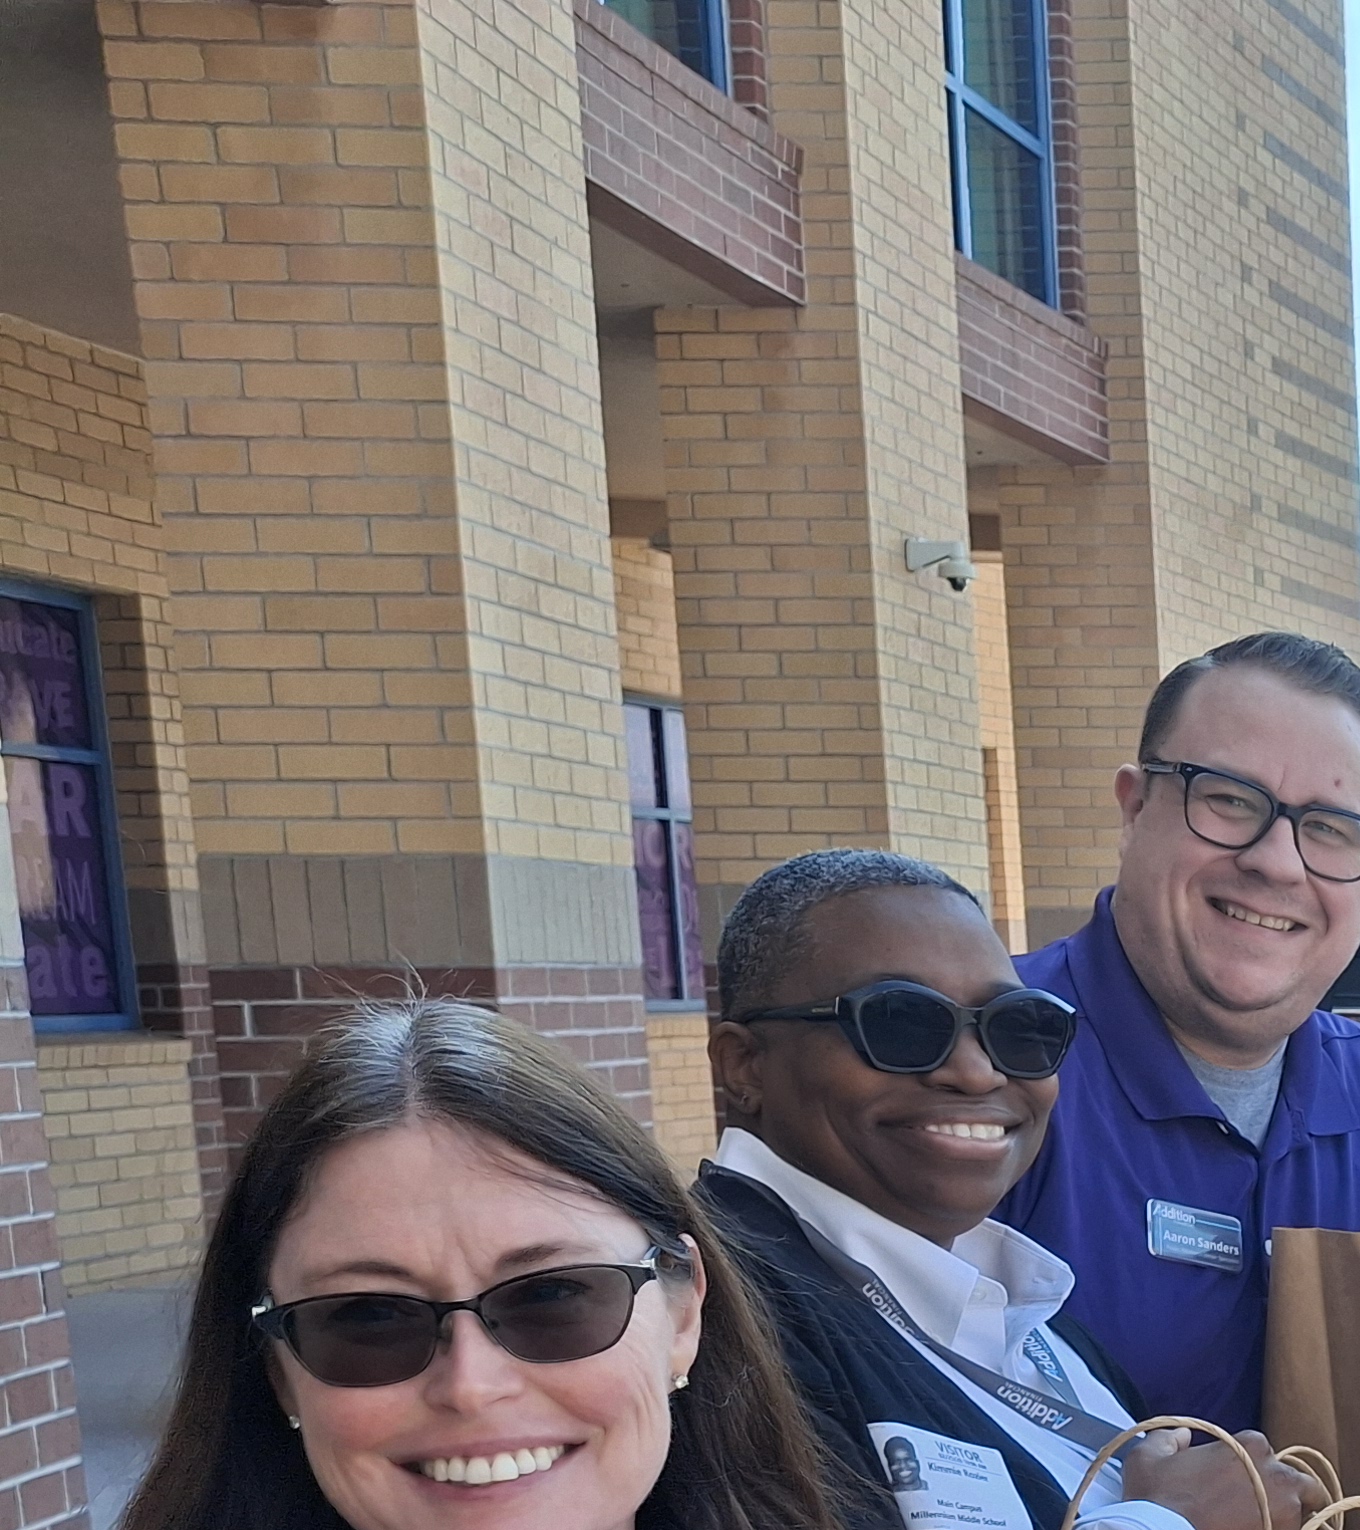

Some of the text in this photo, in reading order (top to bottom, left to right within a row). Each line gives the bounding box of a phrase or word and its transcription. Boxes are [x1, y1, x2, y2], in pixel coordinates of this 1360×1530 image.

[1163, 1229, 1196, 1246] Aaron
[1198, 1237, 1240, 1255] Sanders
[996, 1384, 1073, 1431] Addition
[935, 1441, 982, 1464] VISITOR
